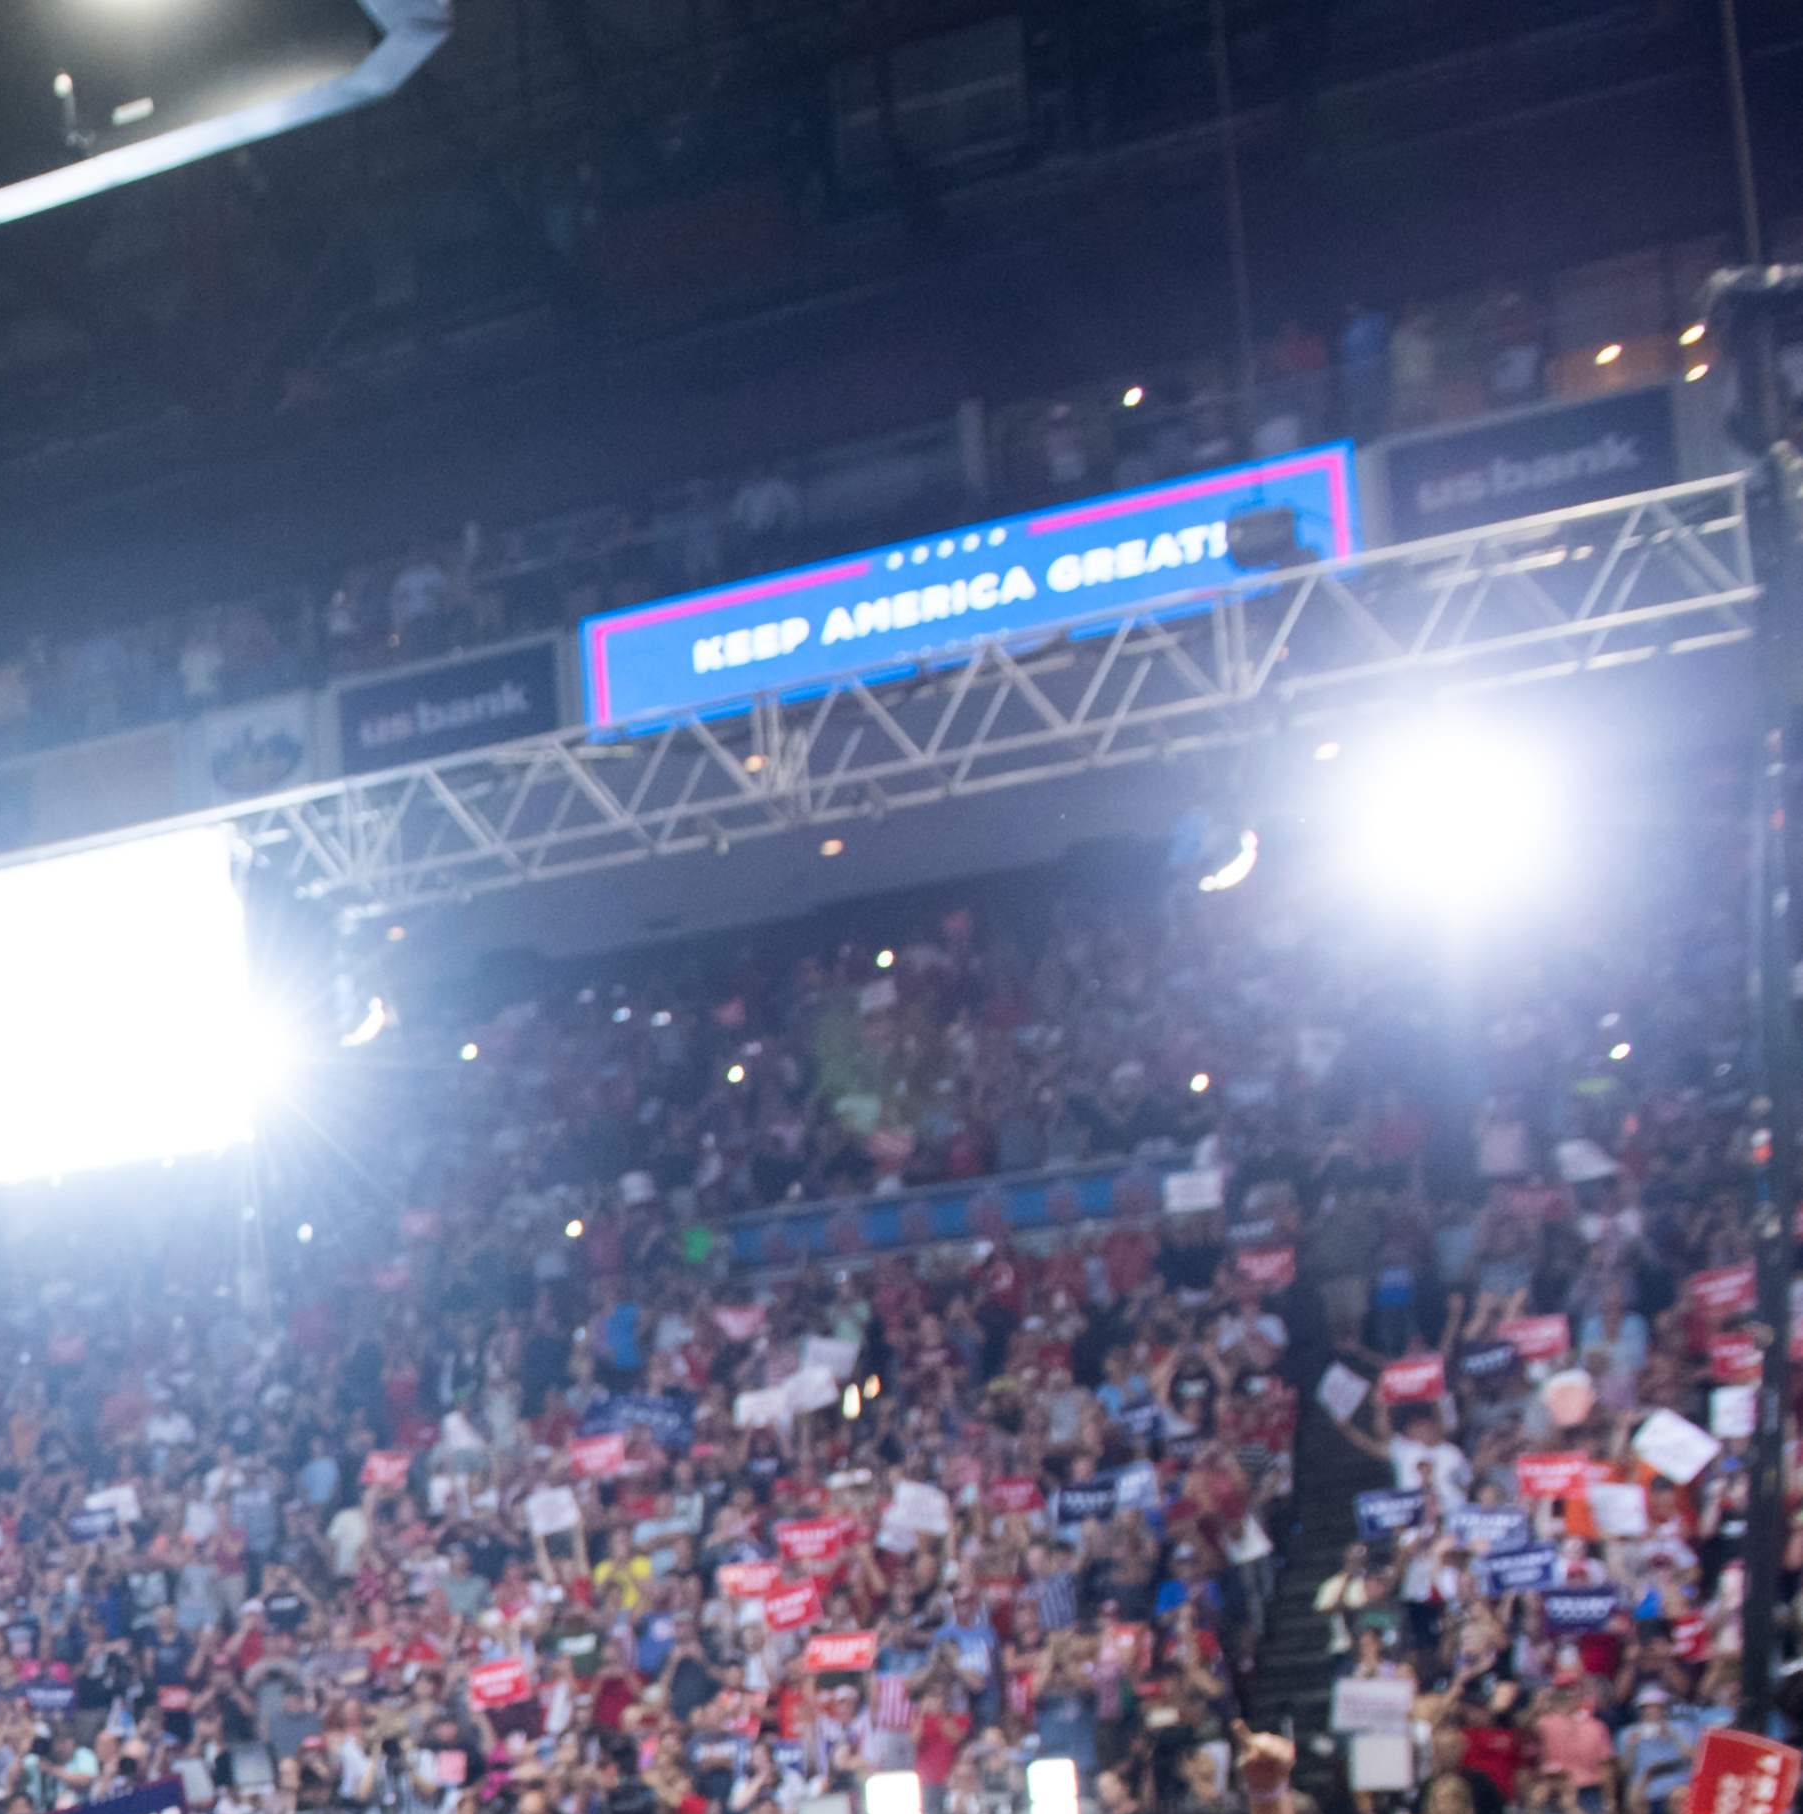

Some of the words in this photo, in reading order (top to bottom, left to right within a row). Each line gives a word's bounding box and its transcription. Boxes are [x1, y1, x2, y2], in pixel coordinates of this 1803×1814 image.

[692, 616, 810, 674] KEEP
[821, 566, 1036, 645] AMERICA
[1047, 520, 1229, 592] GREAT!
